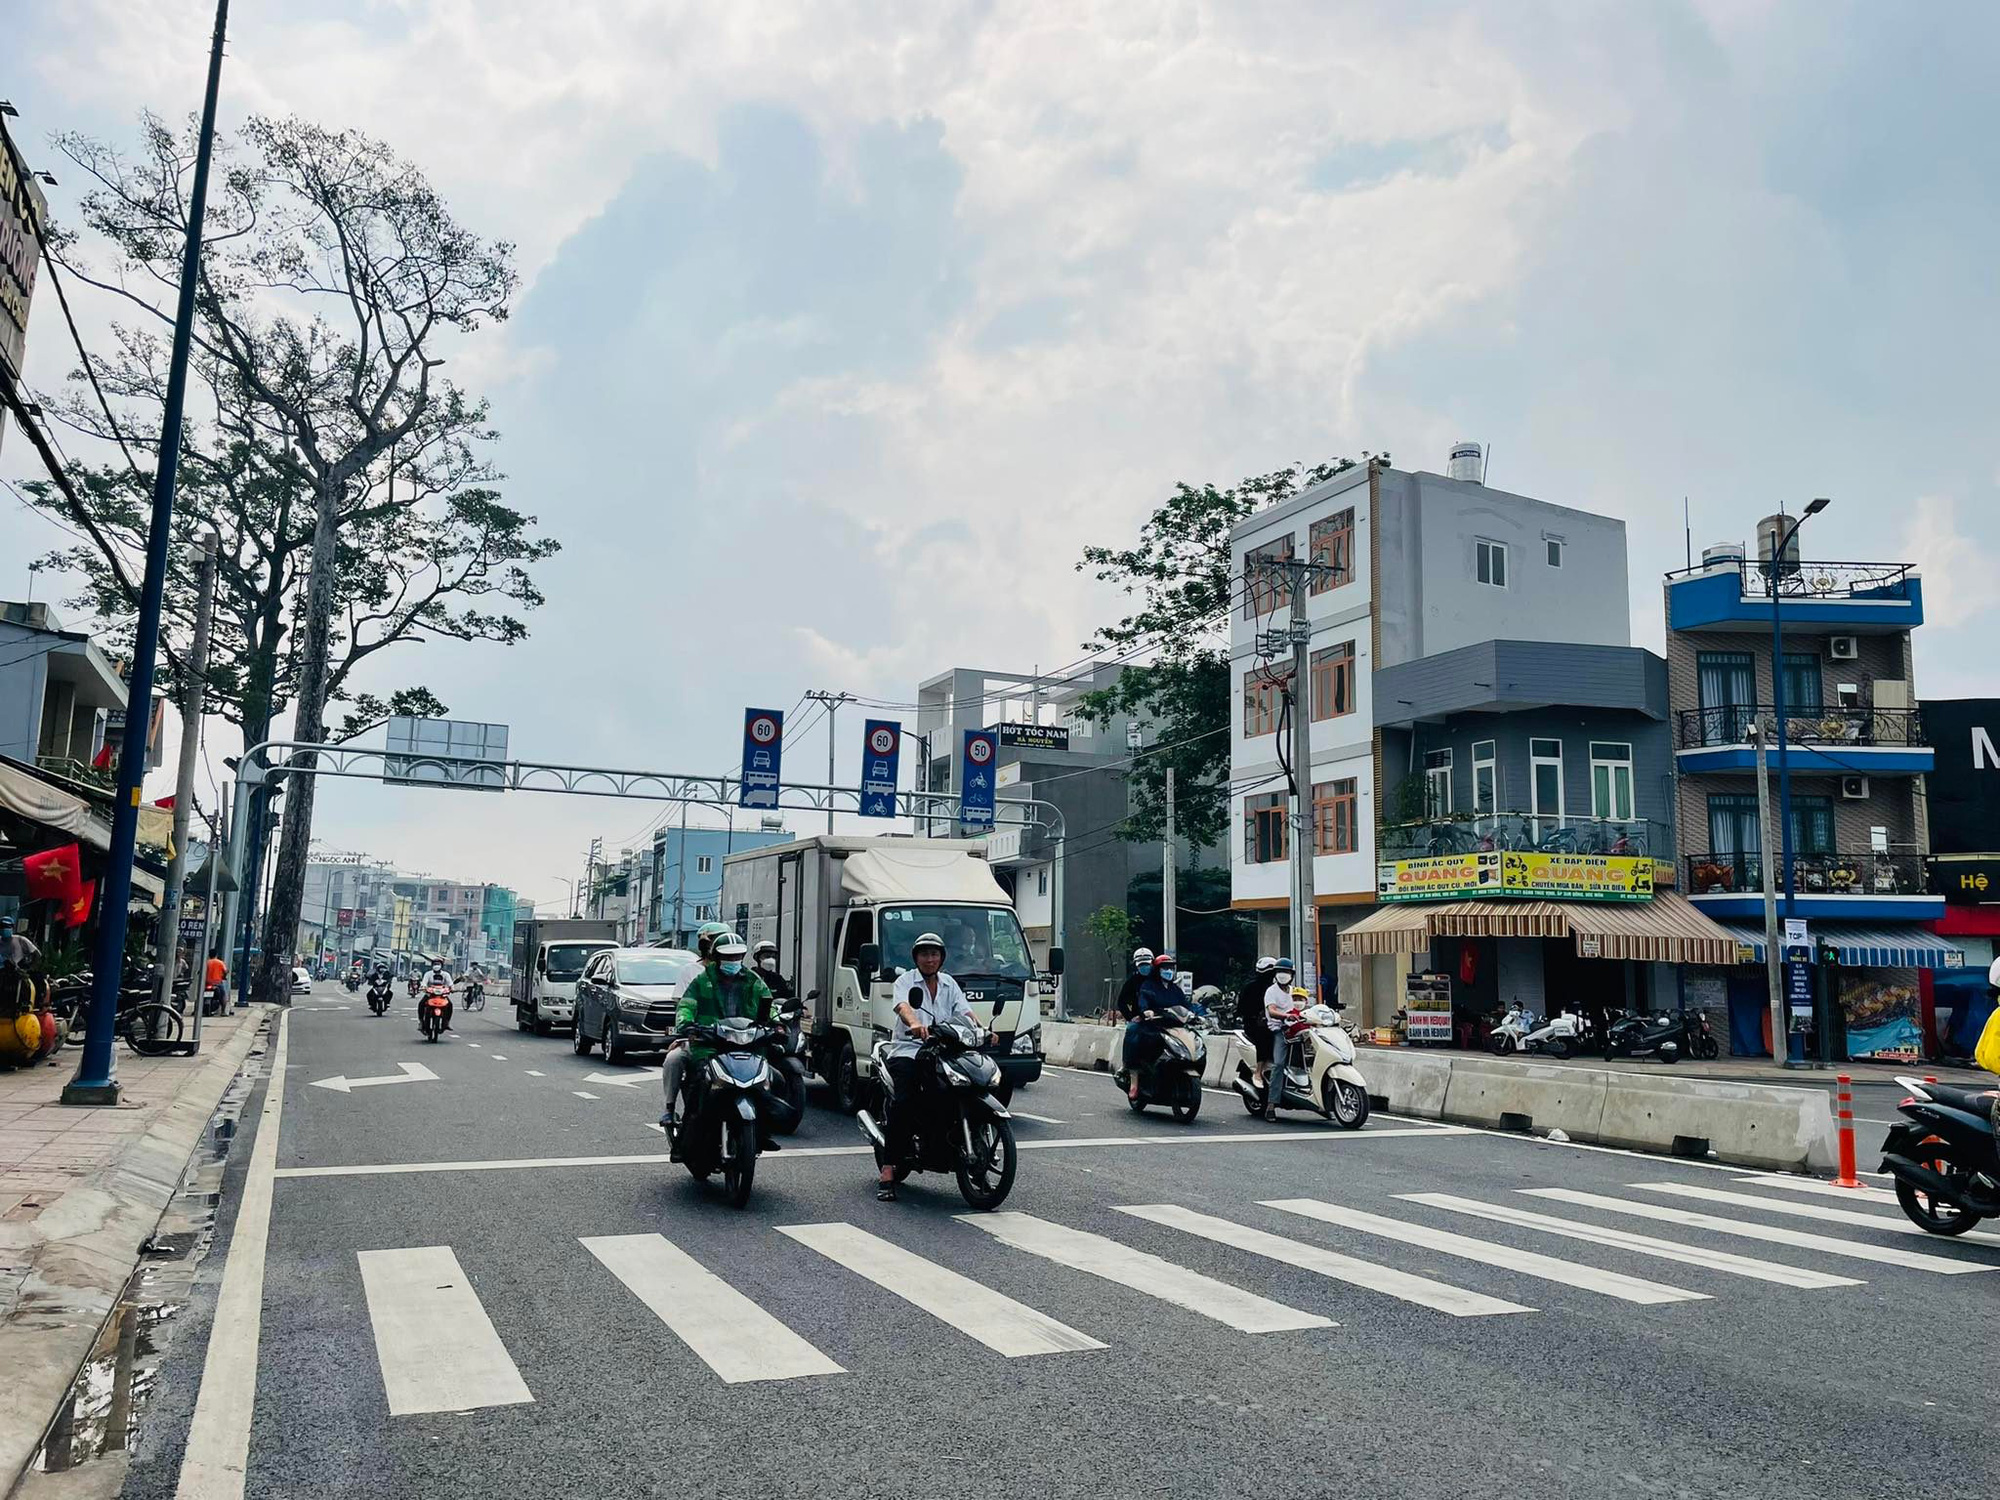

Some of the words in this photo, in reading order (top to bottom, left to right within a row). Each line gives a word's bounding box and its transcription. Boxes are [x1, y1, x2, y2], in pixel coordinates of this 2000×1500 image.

[757, 724, 770, 737] 60
[1024, 726, 1044, 737] TÓC
[1046, 730, 1067, 739] NAM
[876, 735, 888, 747] 60
[974, 744, 986, 756] 50
[1398, 866, 1475, 882] QUANG
[1531, 866, 1625, 882] QUANG
[1960, 872, 1989, 891] Hệ
